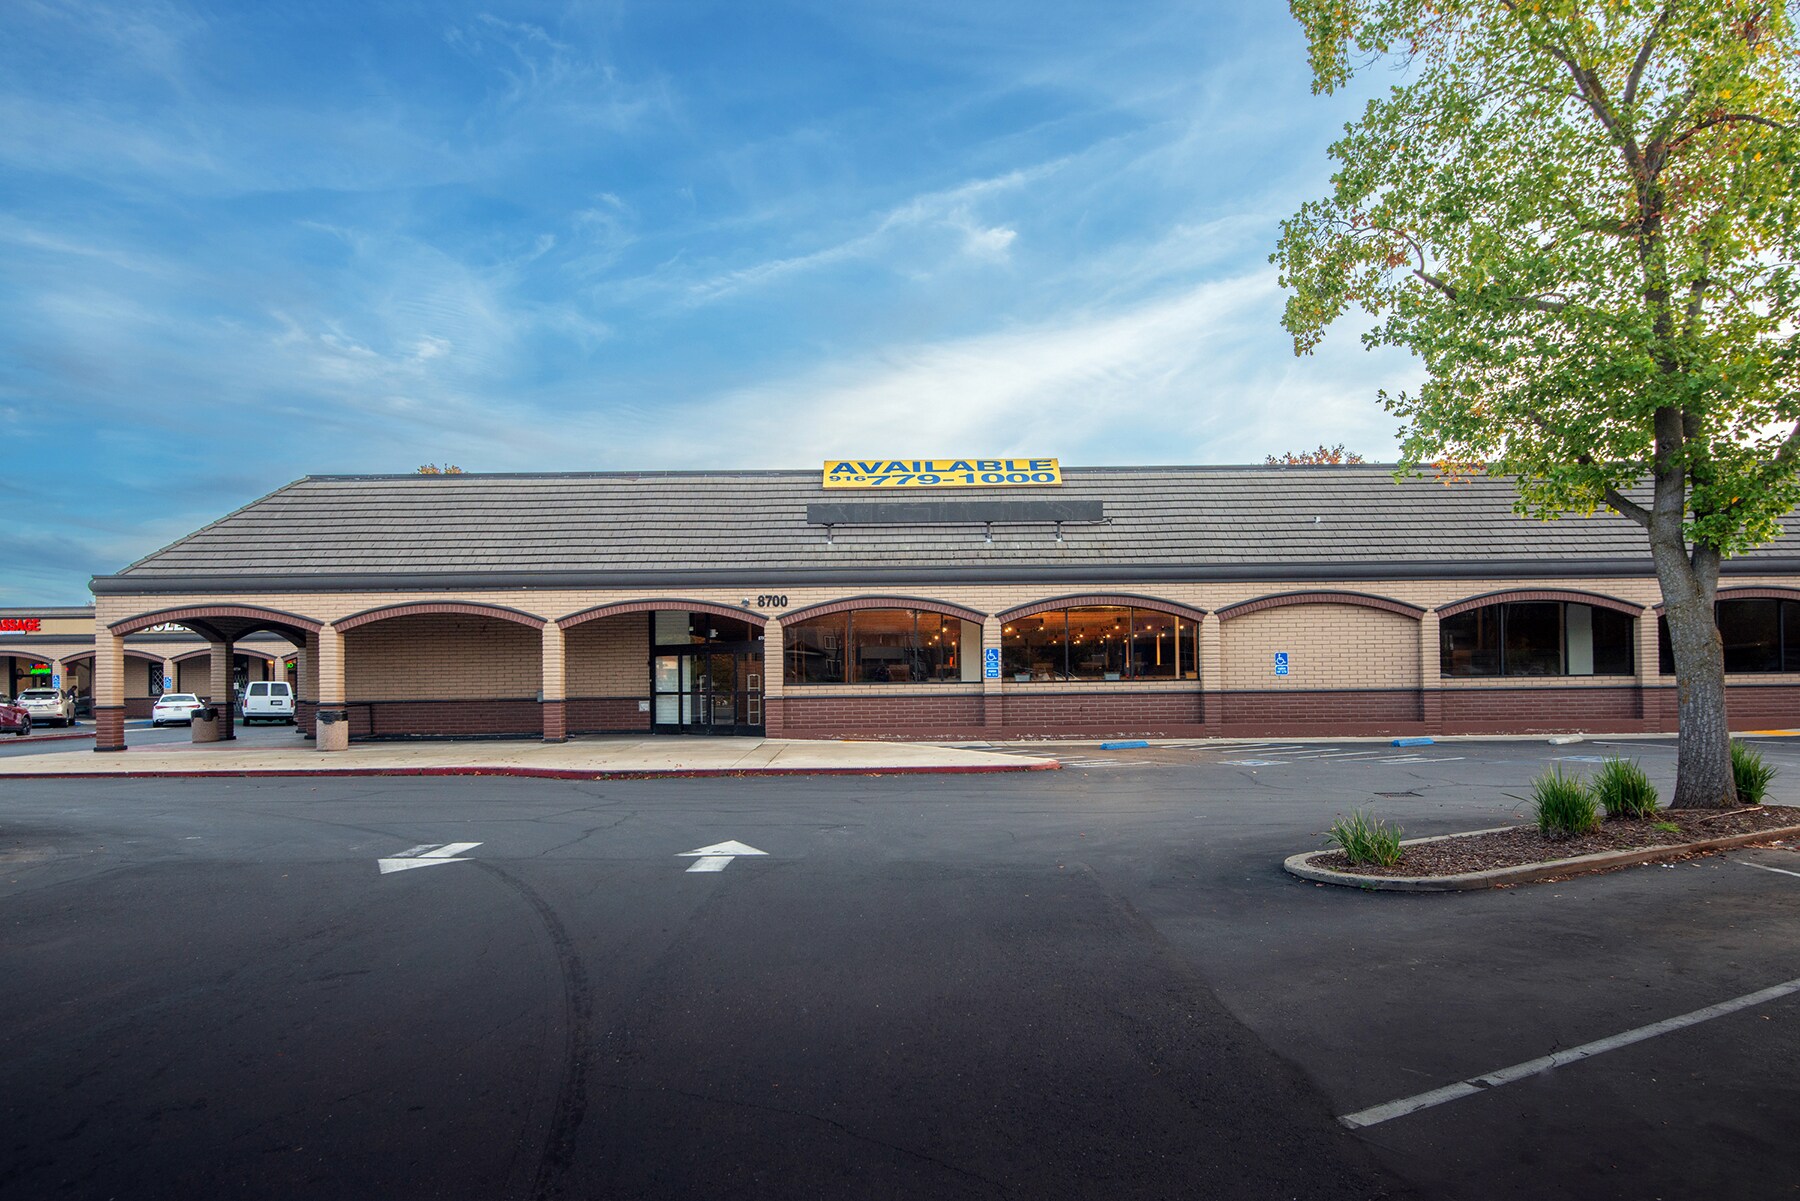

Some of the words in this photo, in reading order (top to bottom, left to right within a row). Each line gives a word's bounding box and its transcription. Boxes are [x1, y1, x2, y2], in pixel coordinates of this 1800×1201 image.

[830, 460, 1054, 474] AVAILABLE
[867, 472, 1056, 486] 779-1000
[757, 594, 788, 608] 8700
[0, 618, 40, 632] SSAGE
